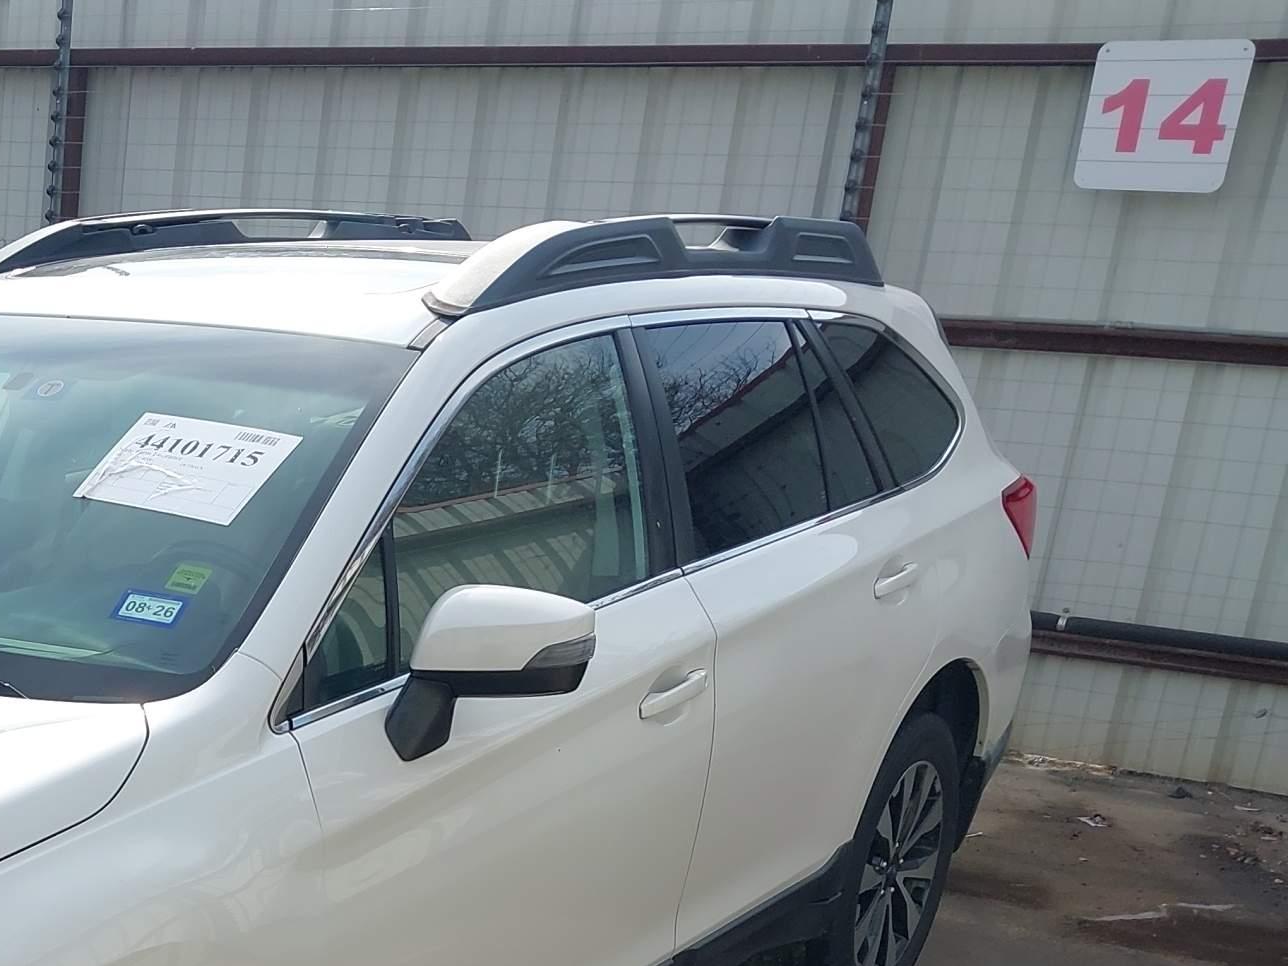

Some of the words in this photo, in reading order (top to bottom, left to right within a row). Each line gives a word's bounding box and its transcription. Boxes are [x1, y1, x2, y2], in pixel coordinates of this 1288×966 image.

[1101, 78, 1228, 156] 14
[135, 433, 265, 467] 44101715
[125, 600, 147, 613] 08
[153, 604, 176, 618] 26
